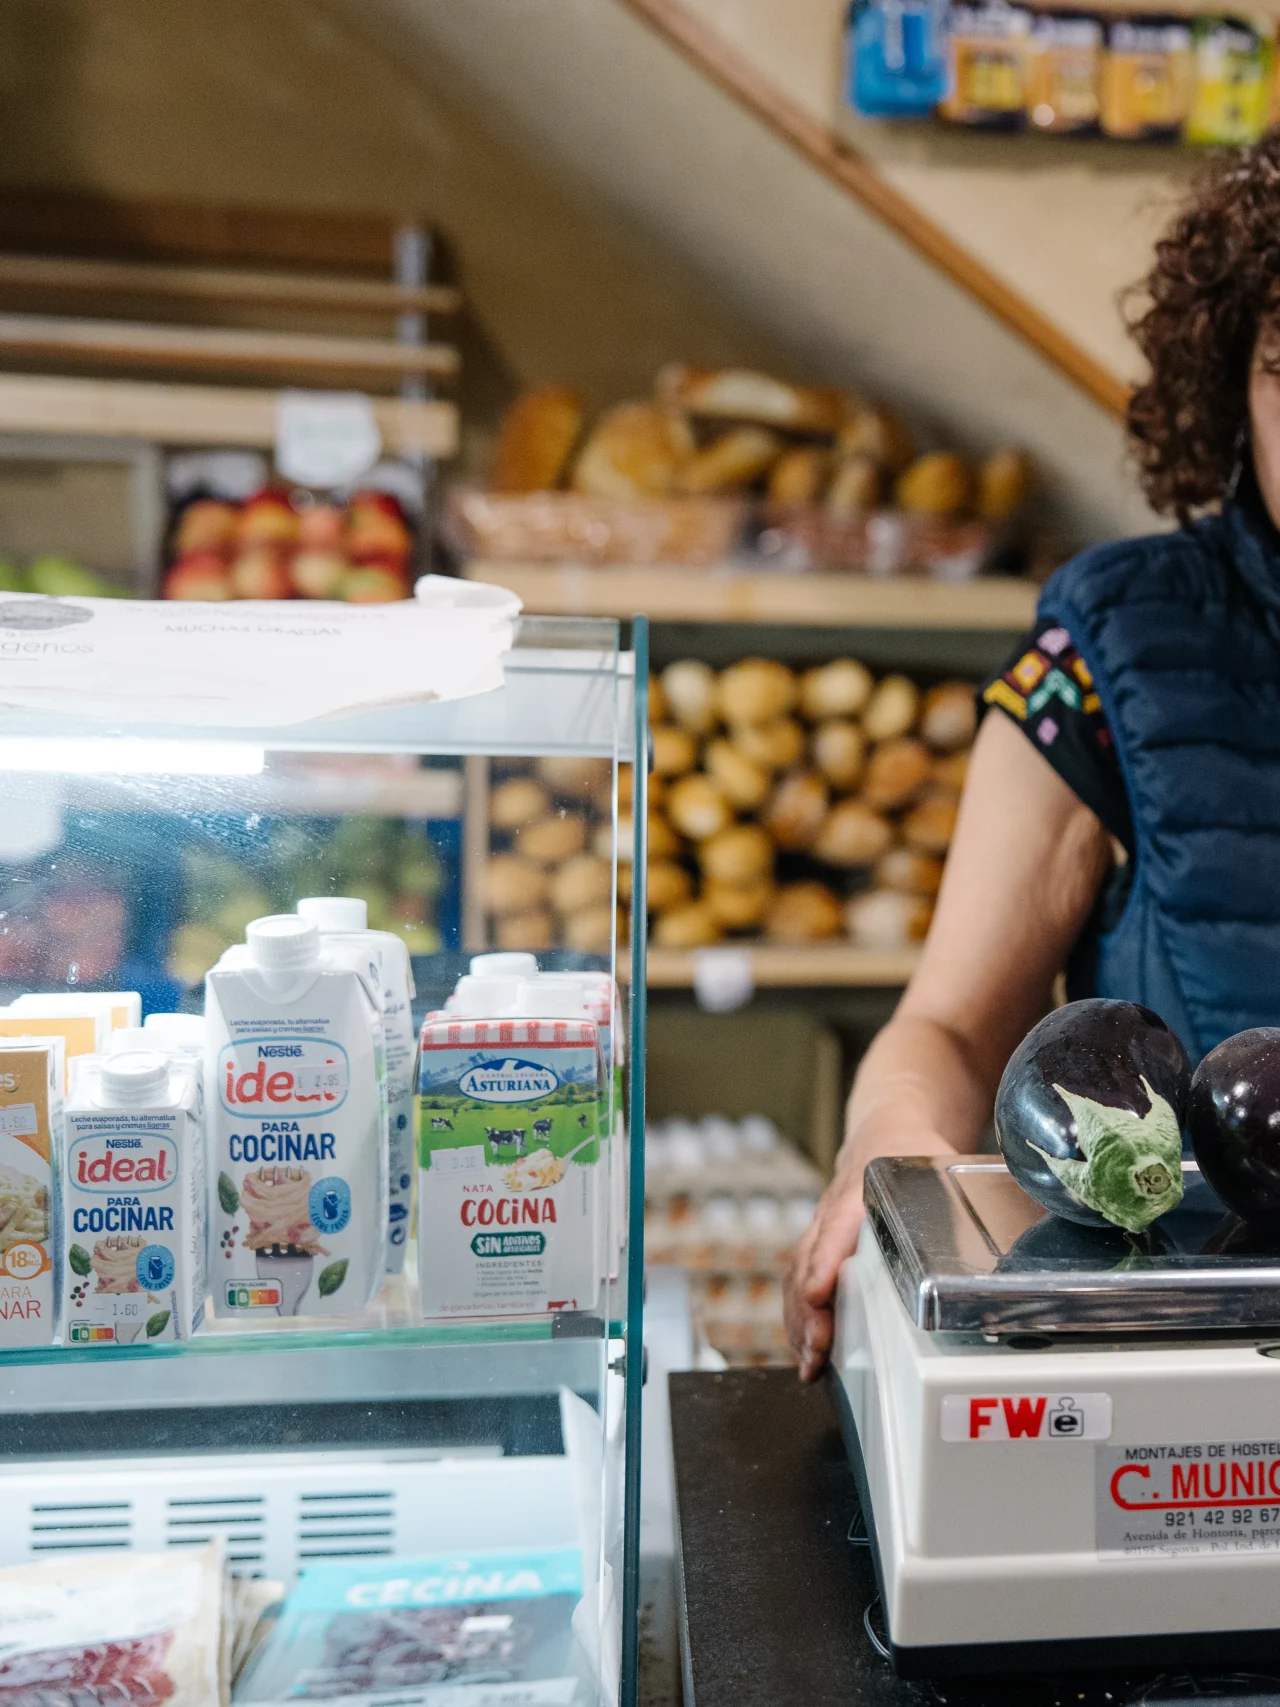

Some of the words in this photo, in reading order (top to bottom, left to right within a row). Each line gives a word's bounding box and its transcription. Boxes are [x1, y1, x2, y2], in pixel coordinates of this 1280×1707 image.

[466, 1075, 551, 1092] ASTURIANA
[70, 1115, 92, 1123] Leche
[261, 1121, 300, 1132] PARA
[229, 1132, 337, 1163] COCINAR
[77, 1149, 167, 1184] ideal
[462, 1184, 494, 1193] NATA
[107, 1197, 141, 1206] PARA
[73, 1206, 174, 1233] COCINAR
[112, 1303, 139, 1316] 1.60
[968, 1397, 1048, 1439] FW
[1125, 1445, 1202, 1461] MONTAJES
[1208, 1445, 1226, 1458] DE
[1165, 1512, 1196, 1527] 921
[1203, 1510, 1225, 1525] 42
[1231, 1509, 1253, 1524] 92
[1260, 1507, 1280, 1523] 67
[1123, 1531, 1169, 1542] Avenida
[1173, 1530, 1187, 1540] de
[1191, 1528, 1247, 1540] Hontoria,
[1258, 1540, 1272, 1550] de
